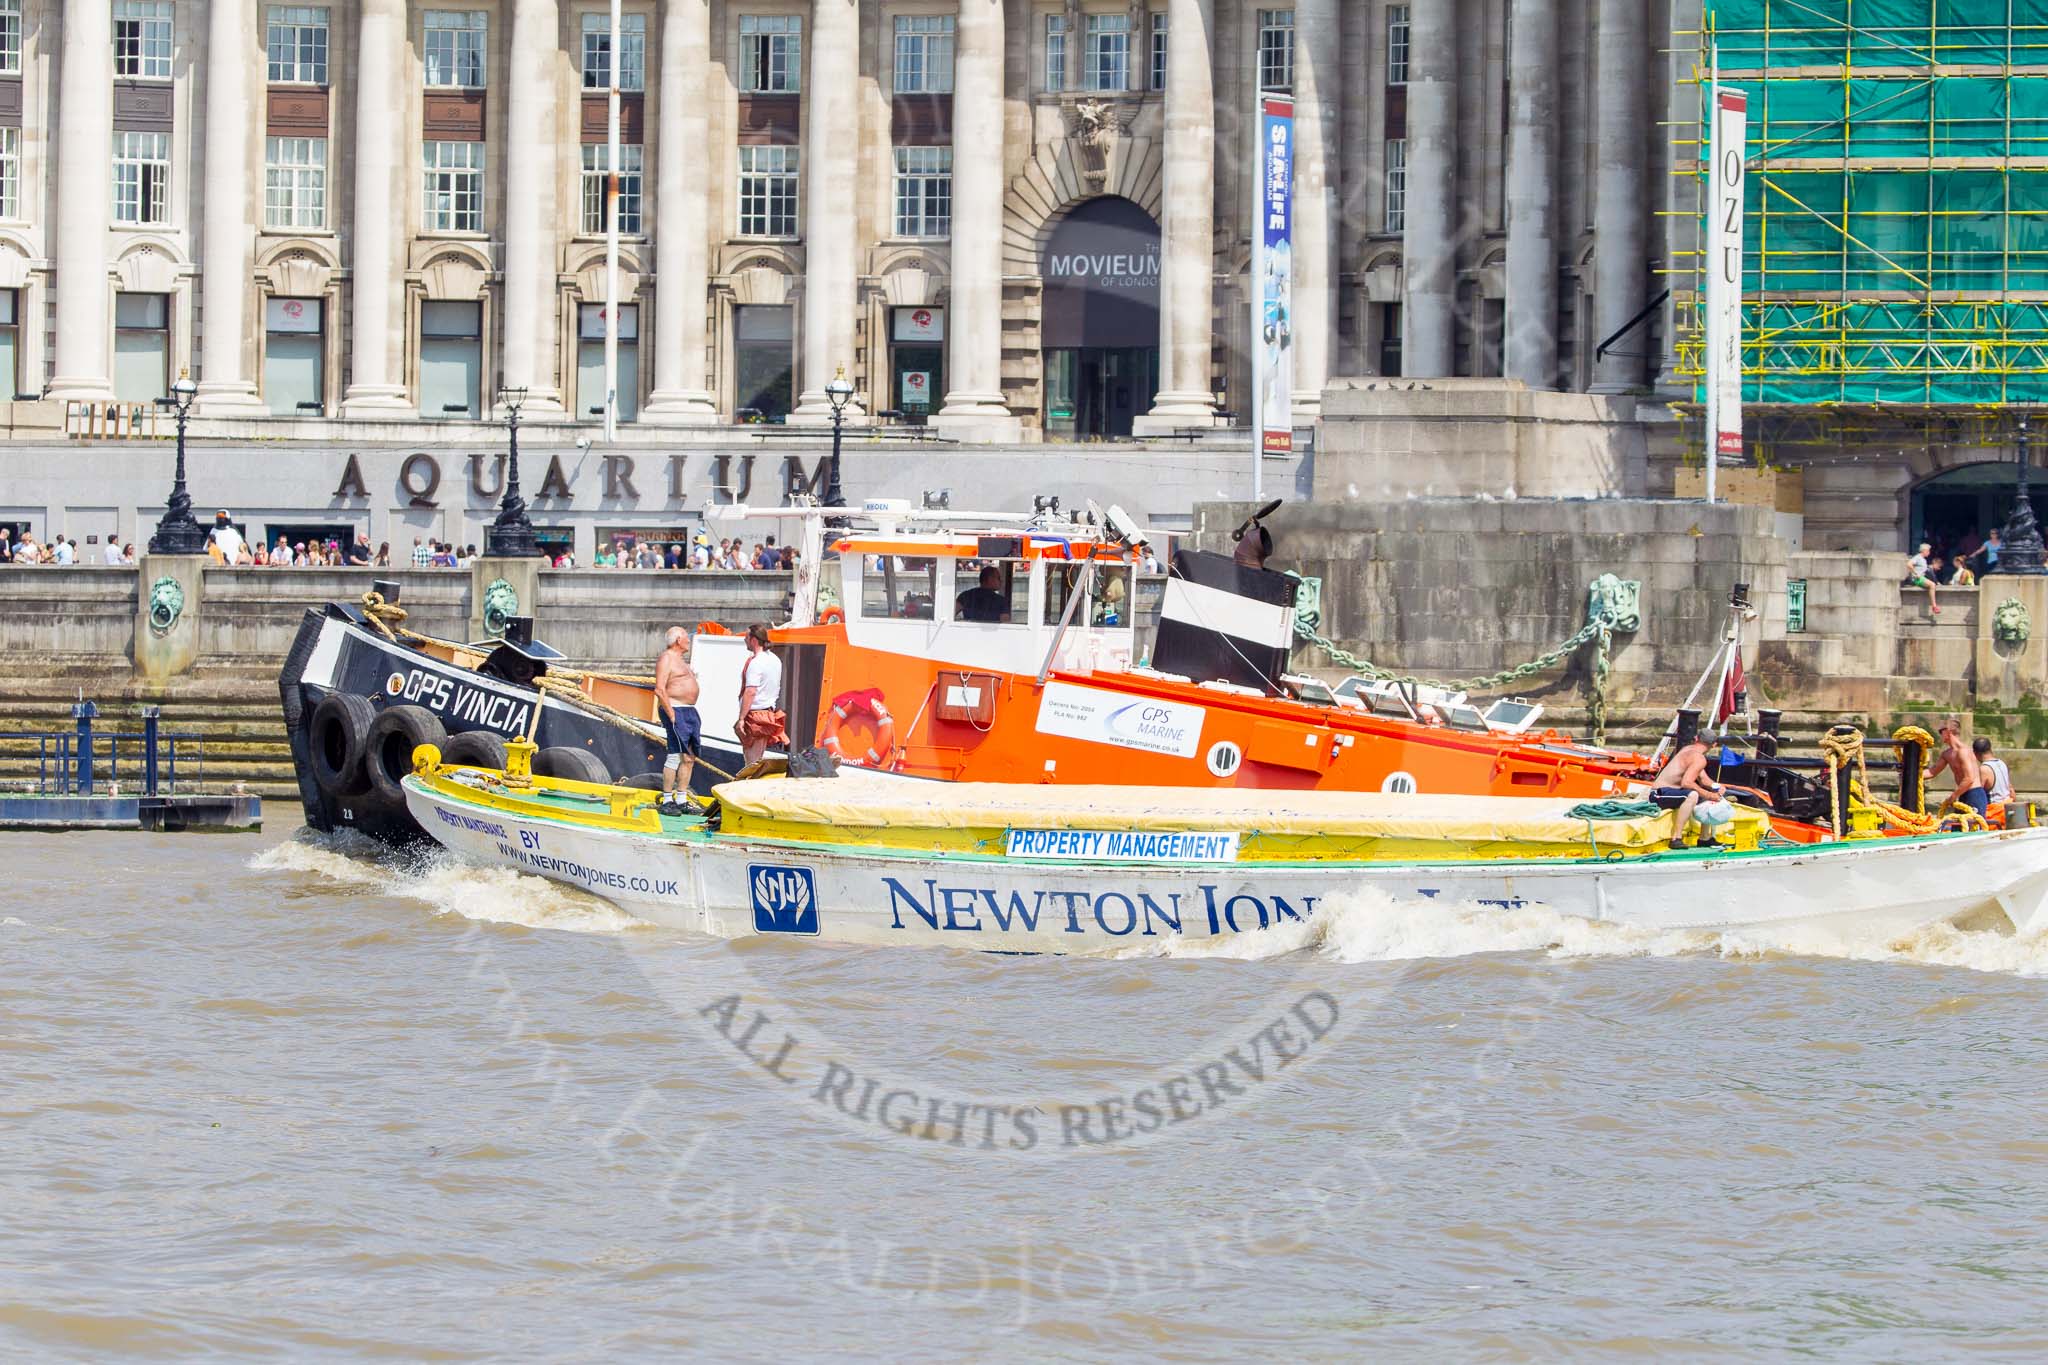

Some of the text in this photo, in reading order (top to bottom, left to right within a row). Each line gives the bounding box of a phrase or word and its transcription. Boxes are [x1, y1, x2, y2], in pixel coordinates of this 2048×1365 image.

[1723, 150, 1741, 284] OZU
[1145, 243, 1161, 252] TH
[1051, 255, 1162, 276] MOVIEUM
[1101, 278, 1161, 287] OF LONDO
[333, 453, 834, 507] AQUARIUM
[403, 669, 529, 735] GPS VINCIA
[1142, 706, 1172, 724] GPS
[1137, 722, 1185, 742] MARINE
[1109, 736, 1180, 753] www.gpsmarine.co.uk
[461, 815, 509, 839] MAINTENANCE
[520, 830, 541, 850] BY
[1011, 831, 1230, 859] PROPERTY MANAGEMENT
[496, 841, 679, 896] WWW.NEWTONJONES.CO.UK
[881, 877, 1183, 936] NEWTON
